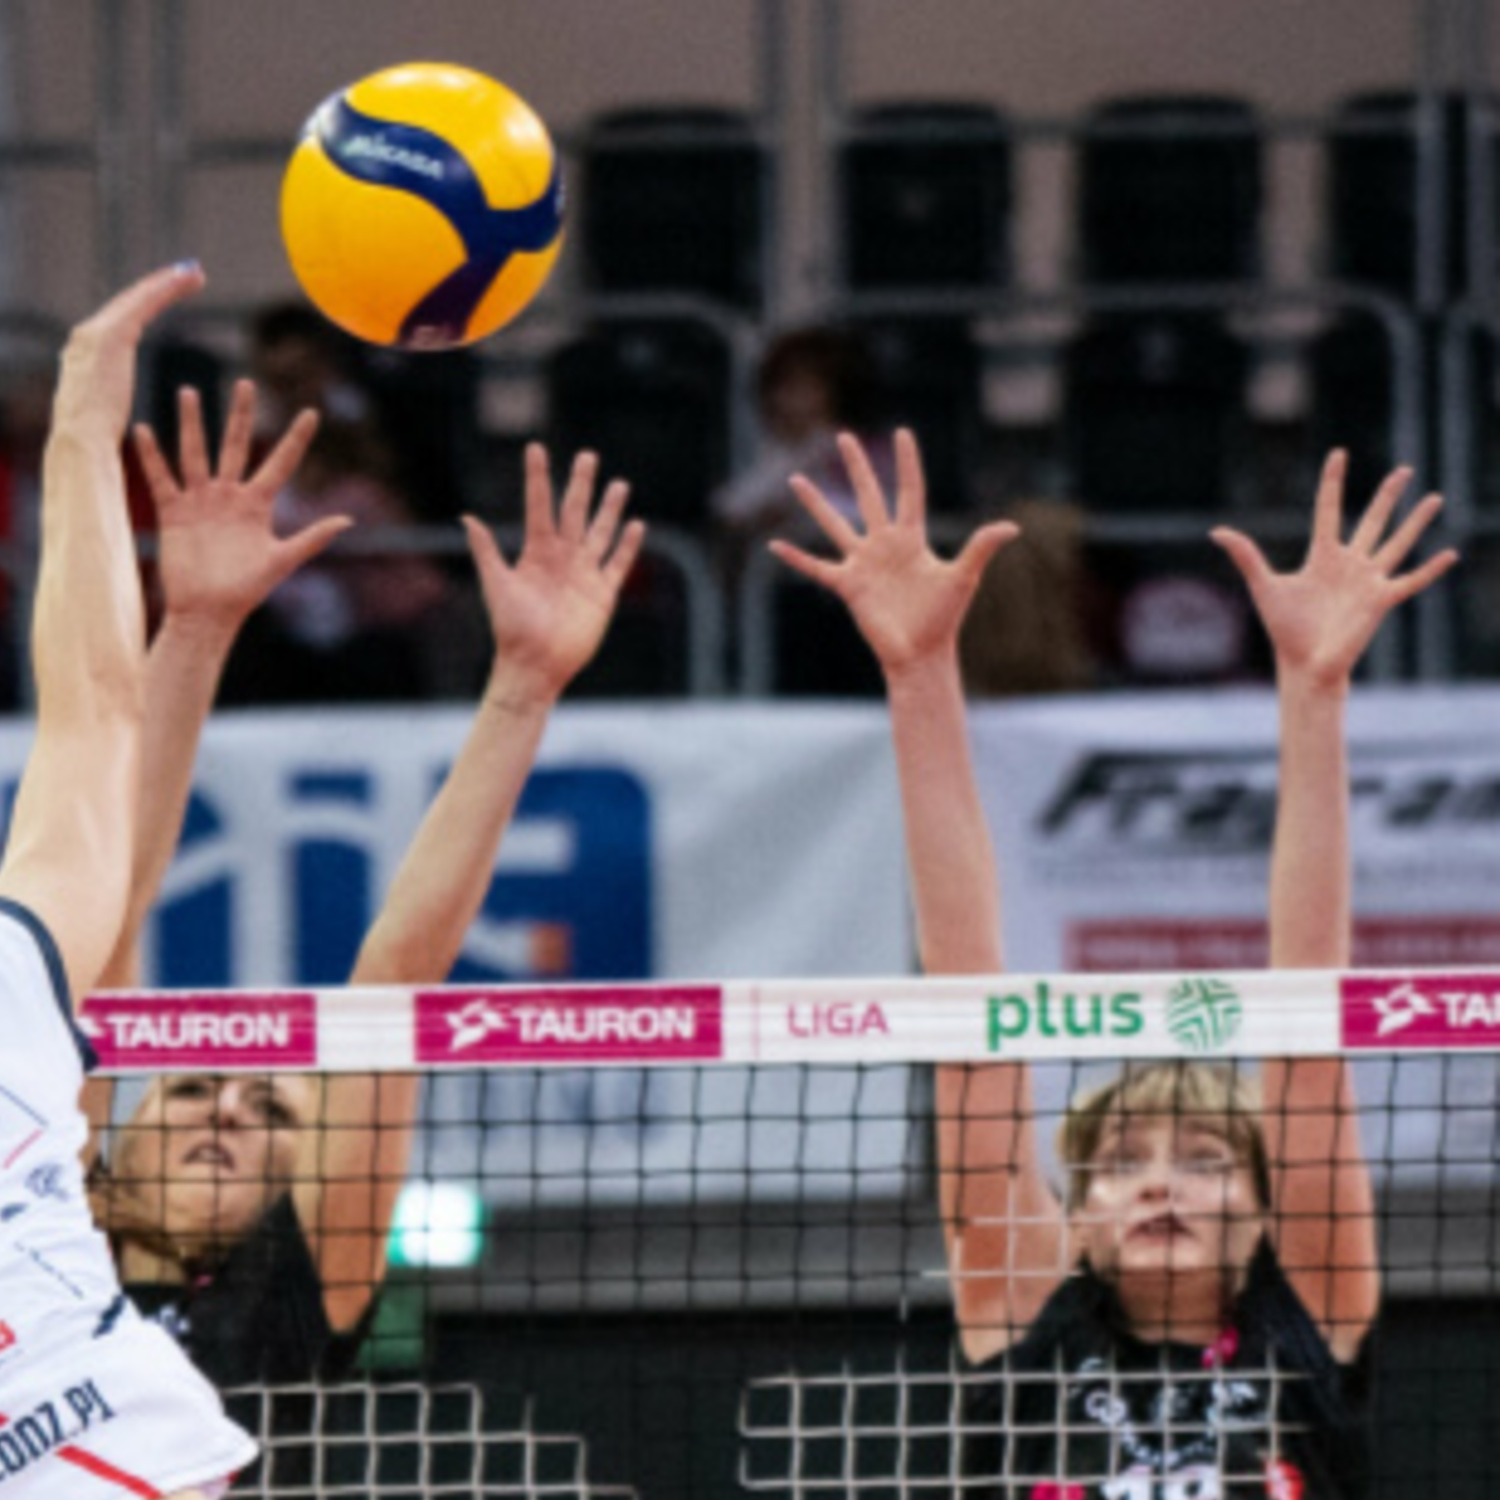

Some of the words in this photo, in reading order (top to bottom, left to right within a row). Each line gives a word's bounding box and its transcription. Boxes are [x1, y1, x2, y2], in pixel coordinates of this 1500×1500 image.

[107, 1012, 288, 1048] TAURON
[513, 1006, 696, 1042] TAURON
[786, 1004, 889, 1037] LIGA
[986, 982, 1145, 1052] plus
